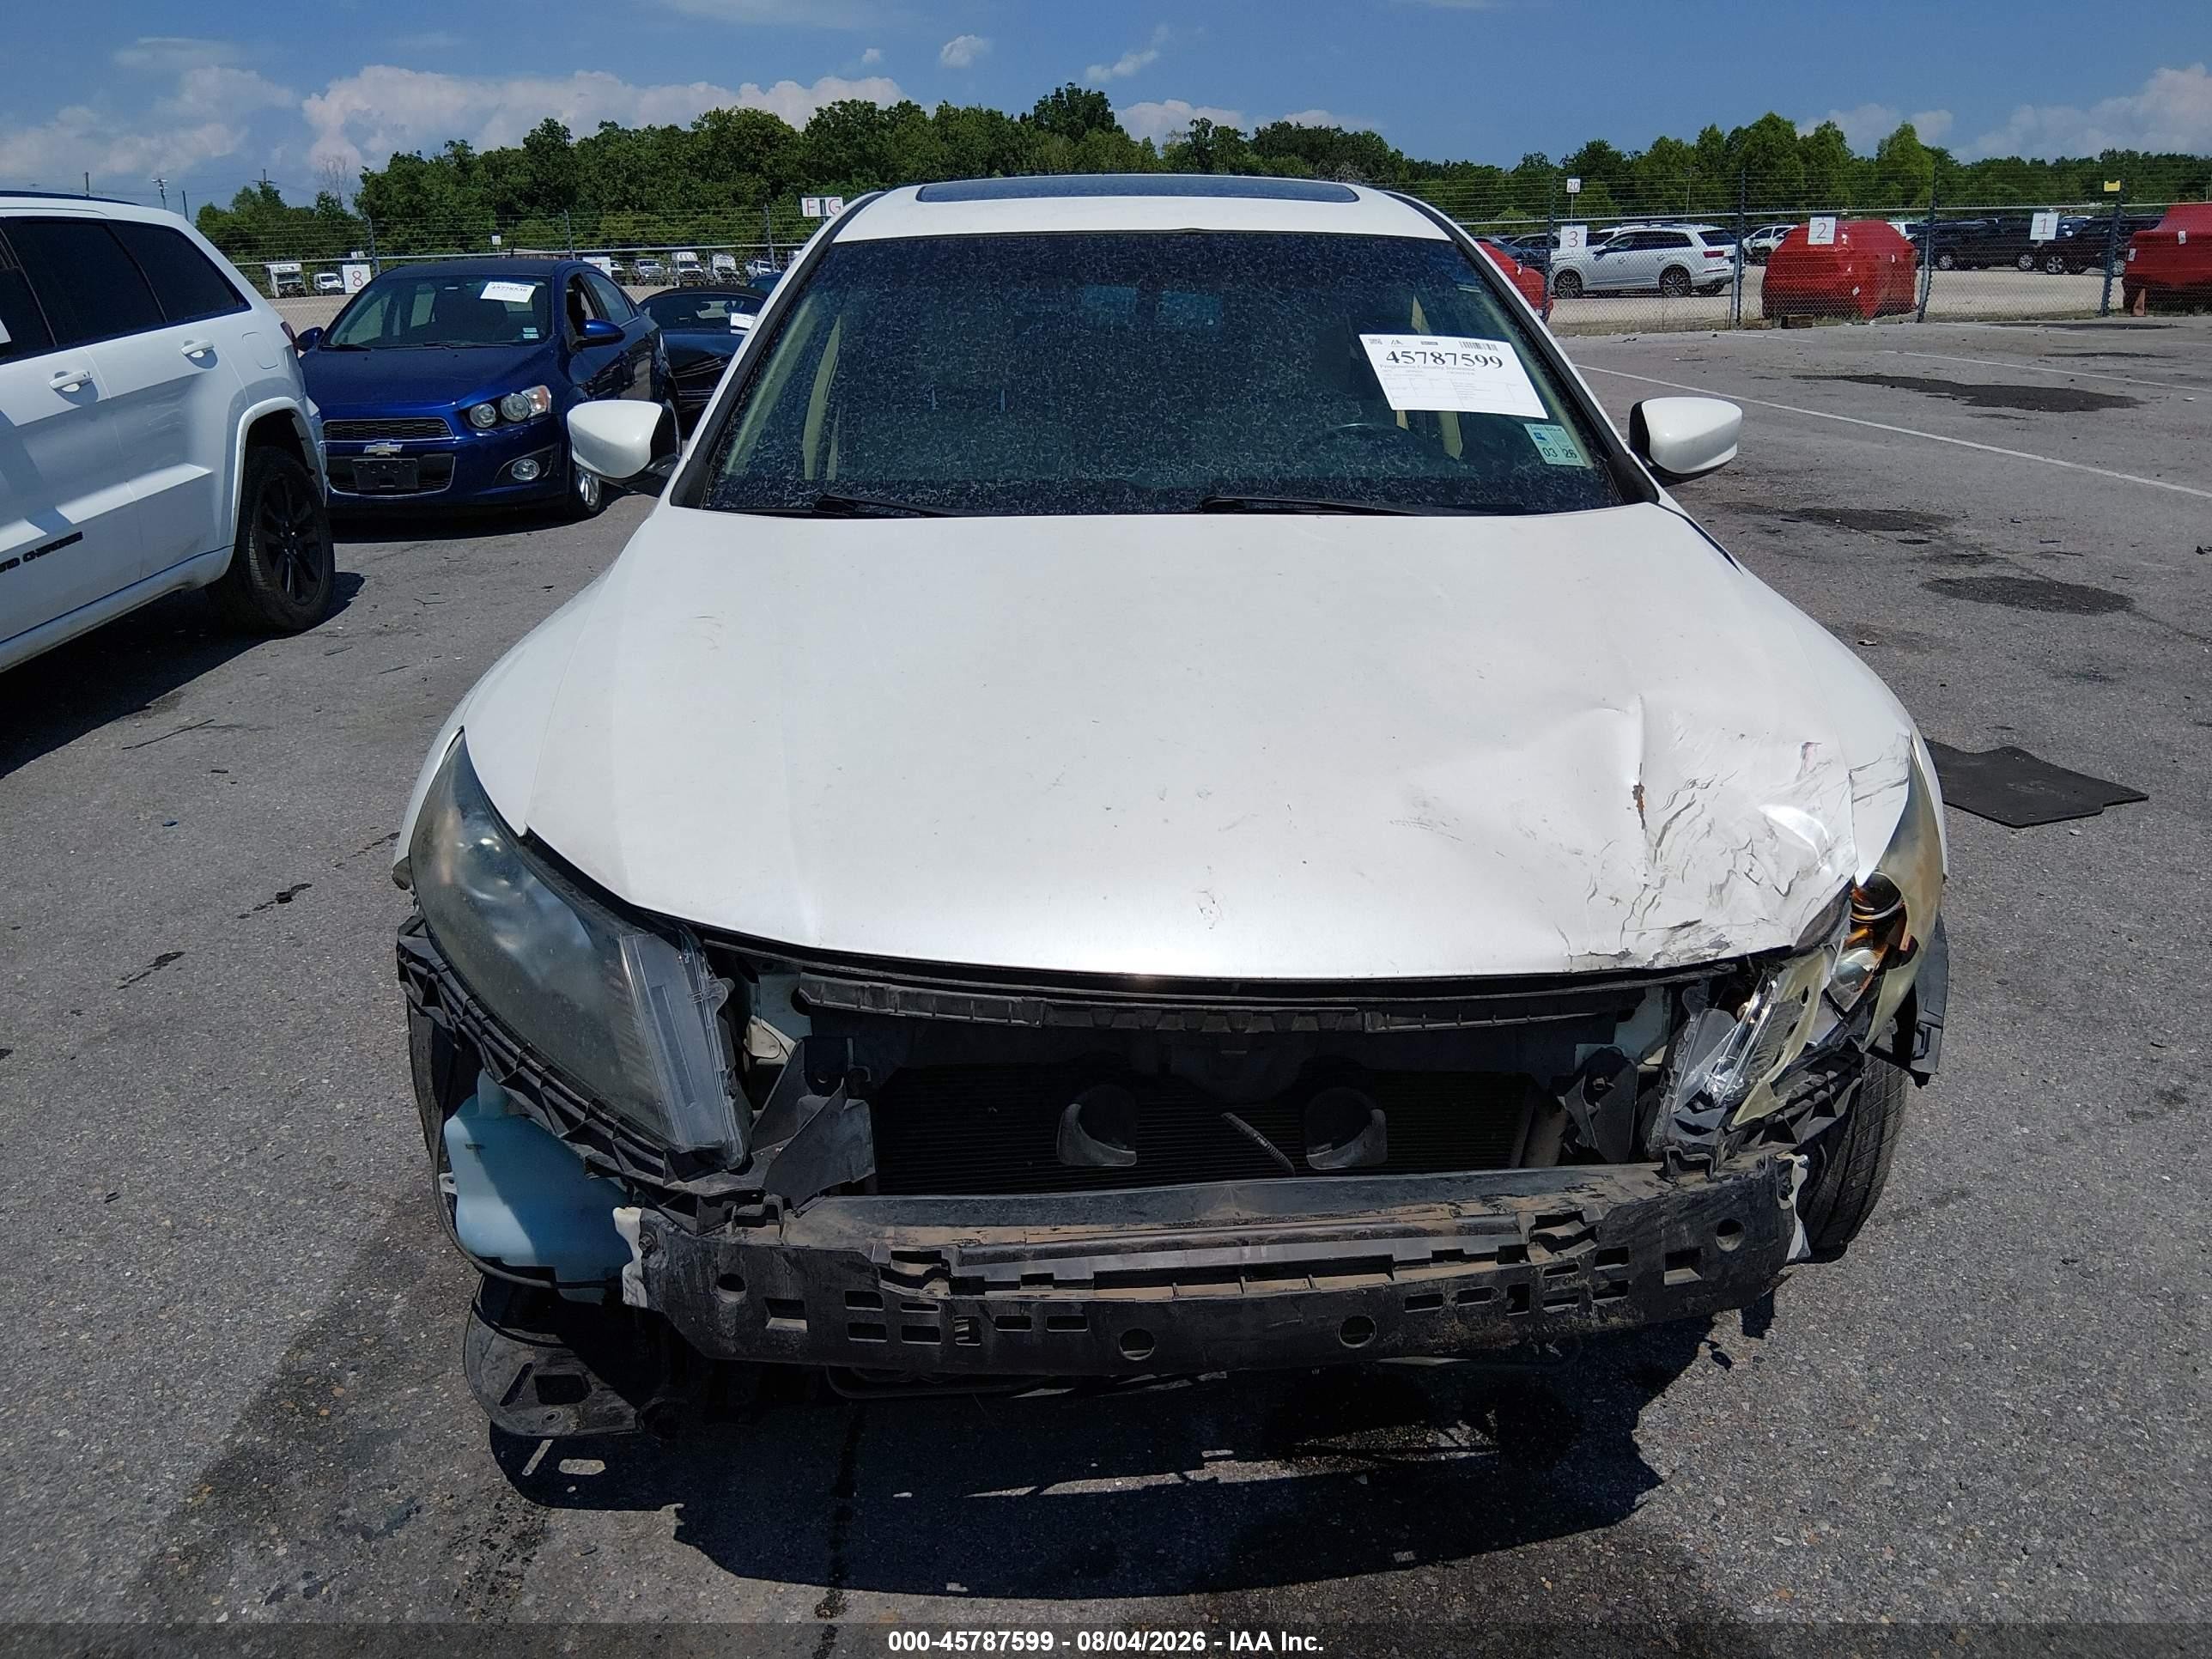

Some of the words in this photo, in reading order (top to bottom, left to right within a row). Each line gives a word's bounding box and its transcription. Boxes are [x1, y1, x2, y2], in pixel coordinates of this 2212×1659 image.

[1568, 181, 1579, 190] 20
[806, 198, 815, 216] F
[1816, 222, 1826, 239] 2
[2039, 217, 2048, 234] 1
[1567, 230, 1578, 248] 3
[352, 270, 363, 287] 8
[1385, 350, 1504, 369] 45787599
[1542, 447, 1558, 457] 03
[1562, 448, 1577, 459] 26
